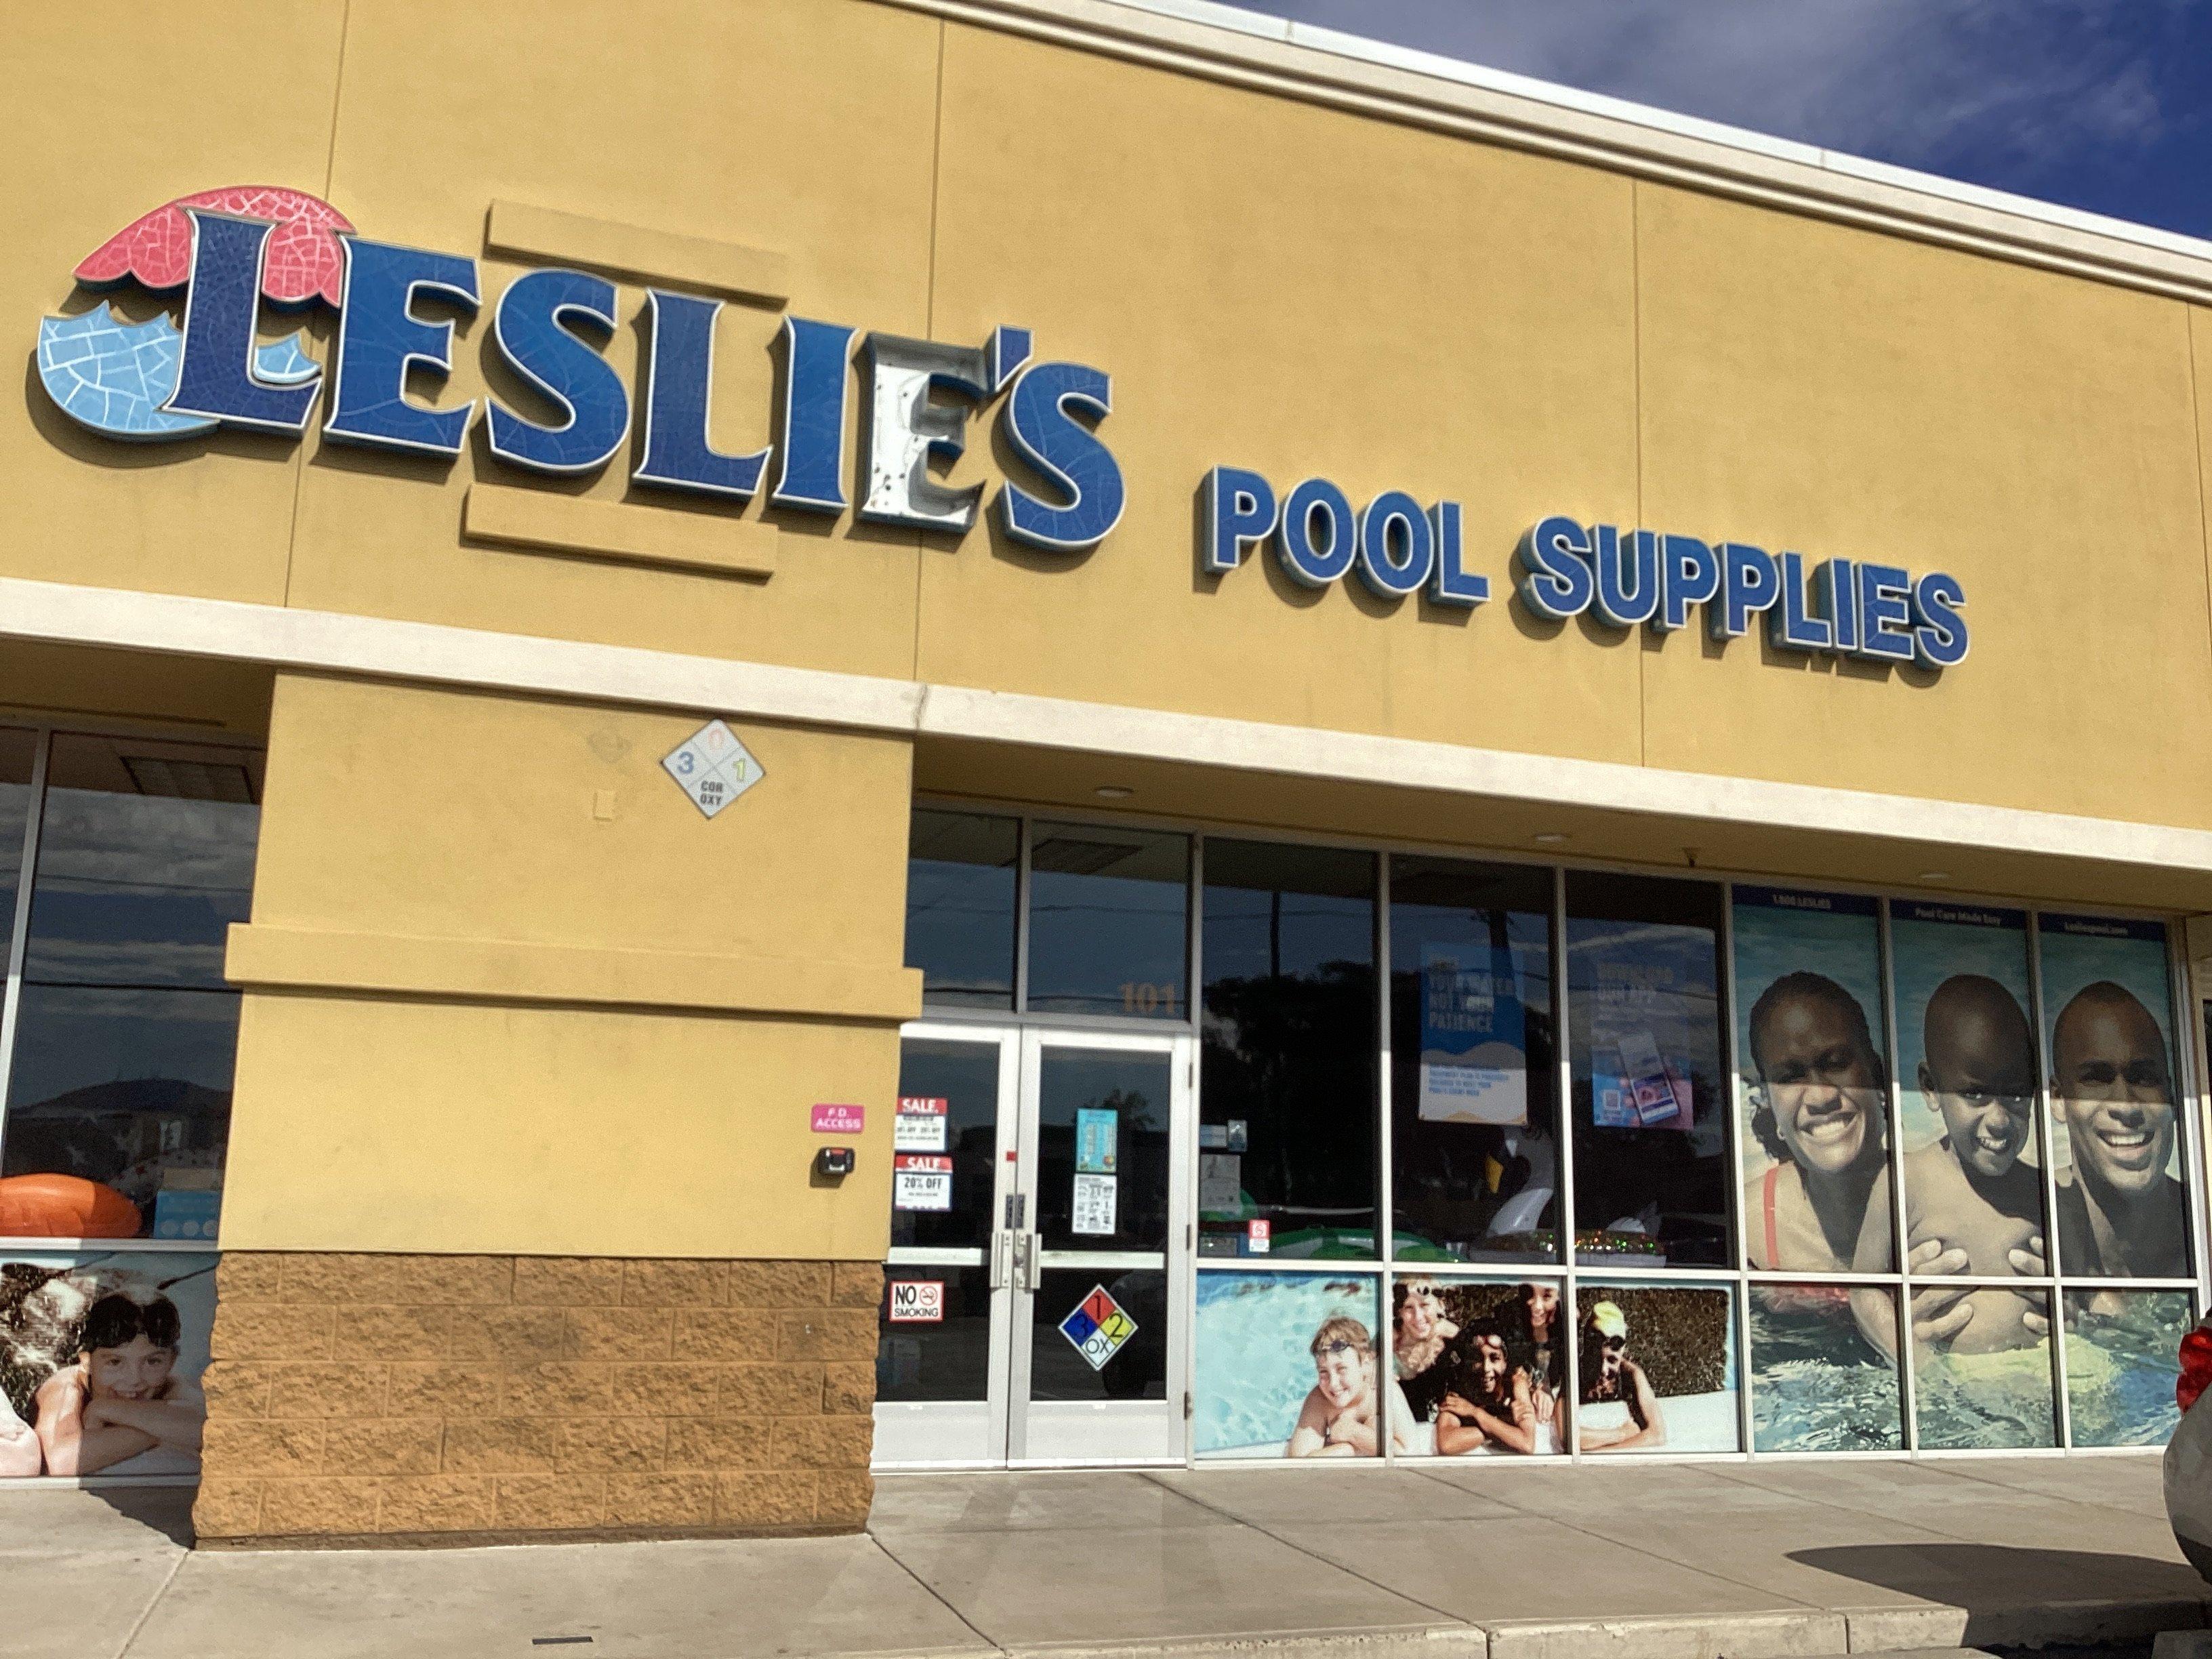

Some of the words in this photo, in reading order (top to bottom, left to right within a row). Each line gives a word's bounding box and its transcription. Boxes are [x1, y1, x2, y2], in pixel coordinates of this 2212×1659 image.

[161, 207, 1126, 552] LESLIE'S
[1205, 464, 1492, 609] POOL
[1520, 514, 1971, 671] SUPPLIES
[678, 750, 694, 775] 3
[733, 758, 747, 783] 1
[1120, 982, 1175, 1015] 101
[815, 1118, 862, 1130] ACCESS
[906, 1156, 941, 1170] SALE
[904, 1177, 924, 1189] 20%
[926, 1177, 943, 1189] OFF
[895, 1285, 916, 1306] NO
[1094, 1294, 1102, 1320] 1
[894, 1307, 939, 1318] SMOKING
[1109, 1312, 1124, 1339] 2
[1085, 1338, 1110, 1355] OX
